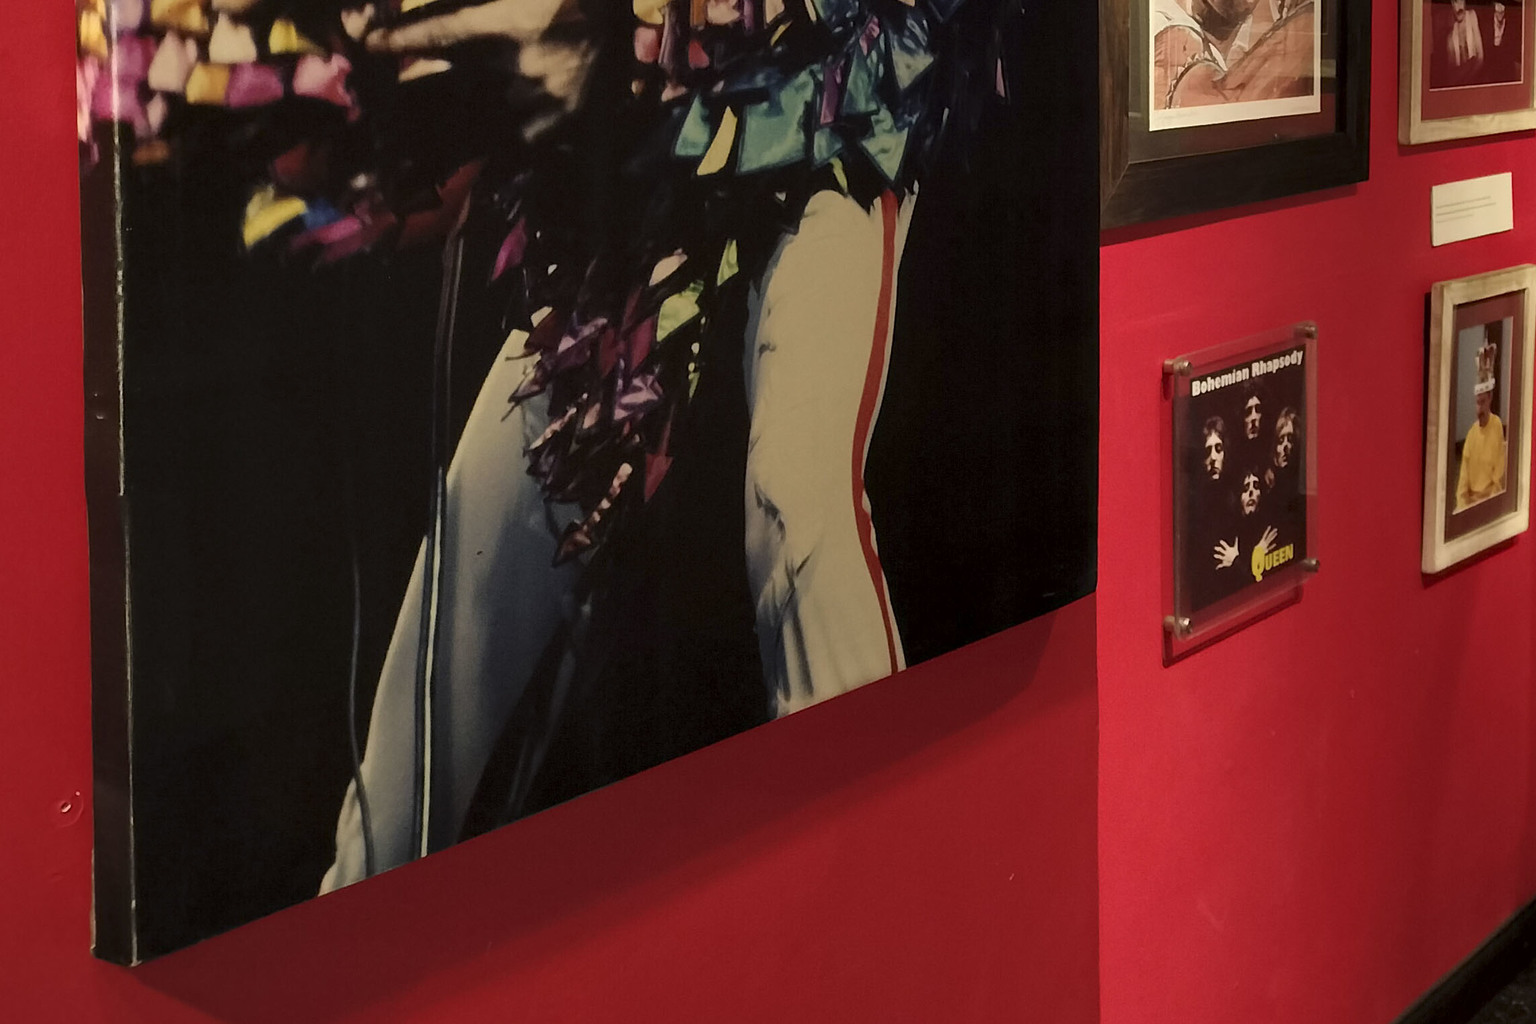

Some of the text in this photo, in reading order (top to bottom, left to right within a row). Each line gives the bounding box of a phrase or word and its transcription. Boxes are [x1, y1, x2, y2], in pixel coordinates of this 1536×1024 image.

[1191, 350, 1304, 397] Bohemian Rhapsody
[1251, 544, 1294, 582] QUEEN
